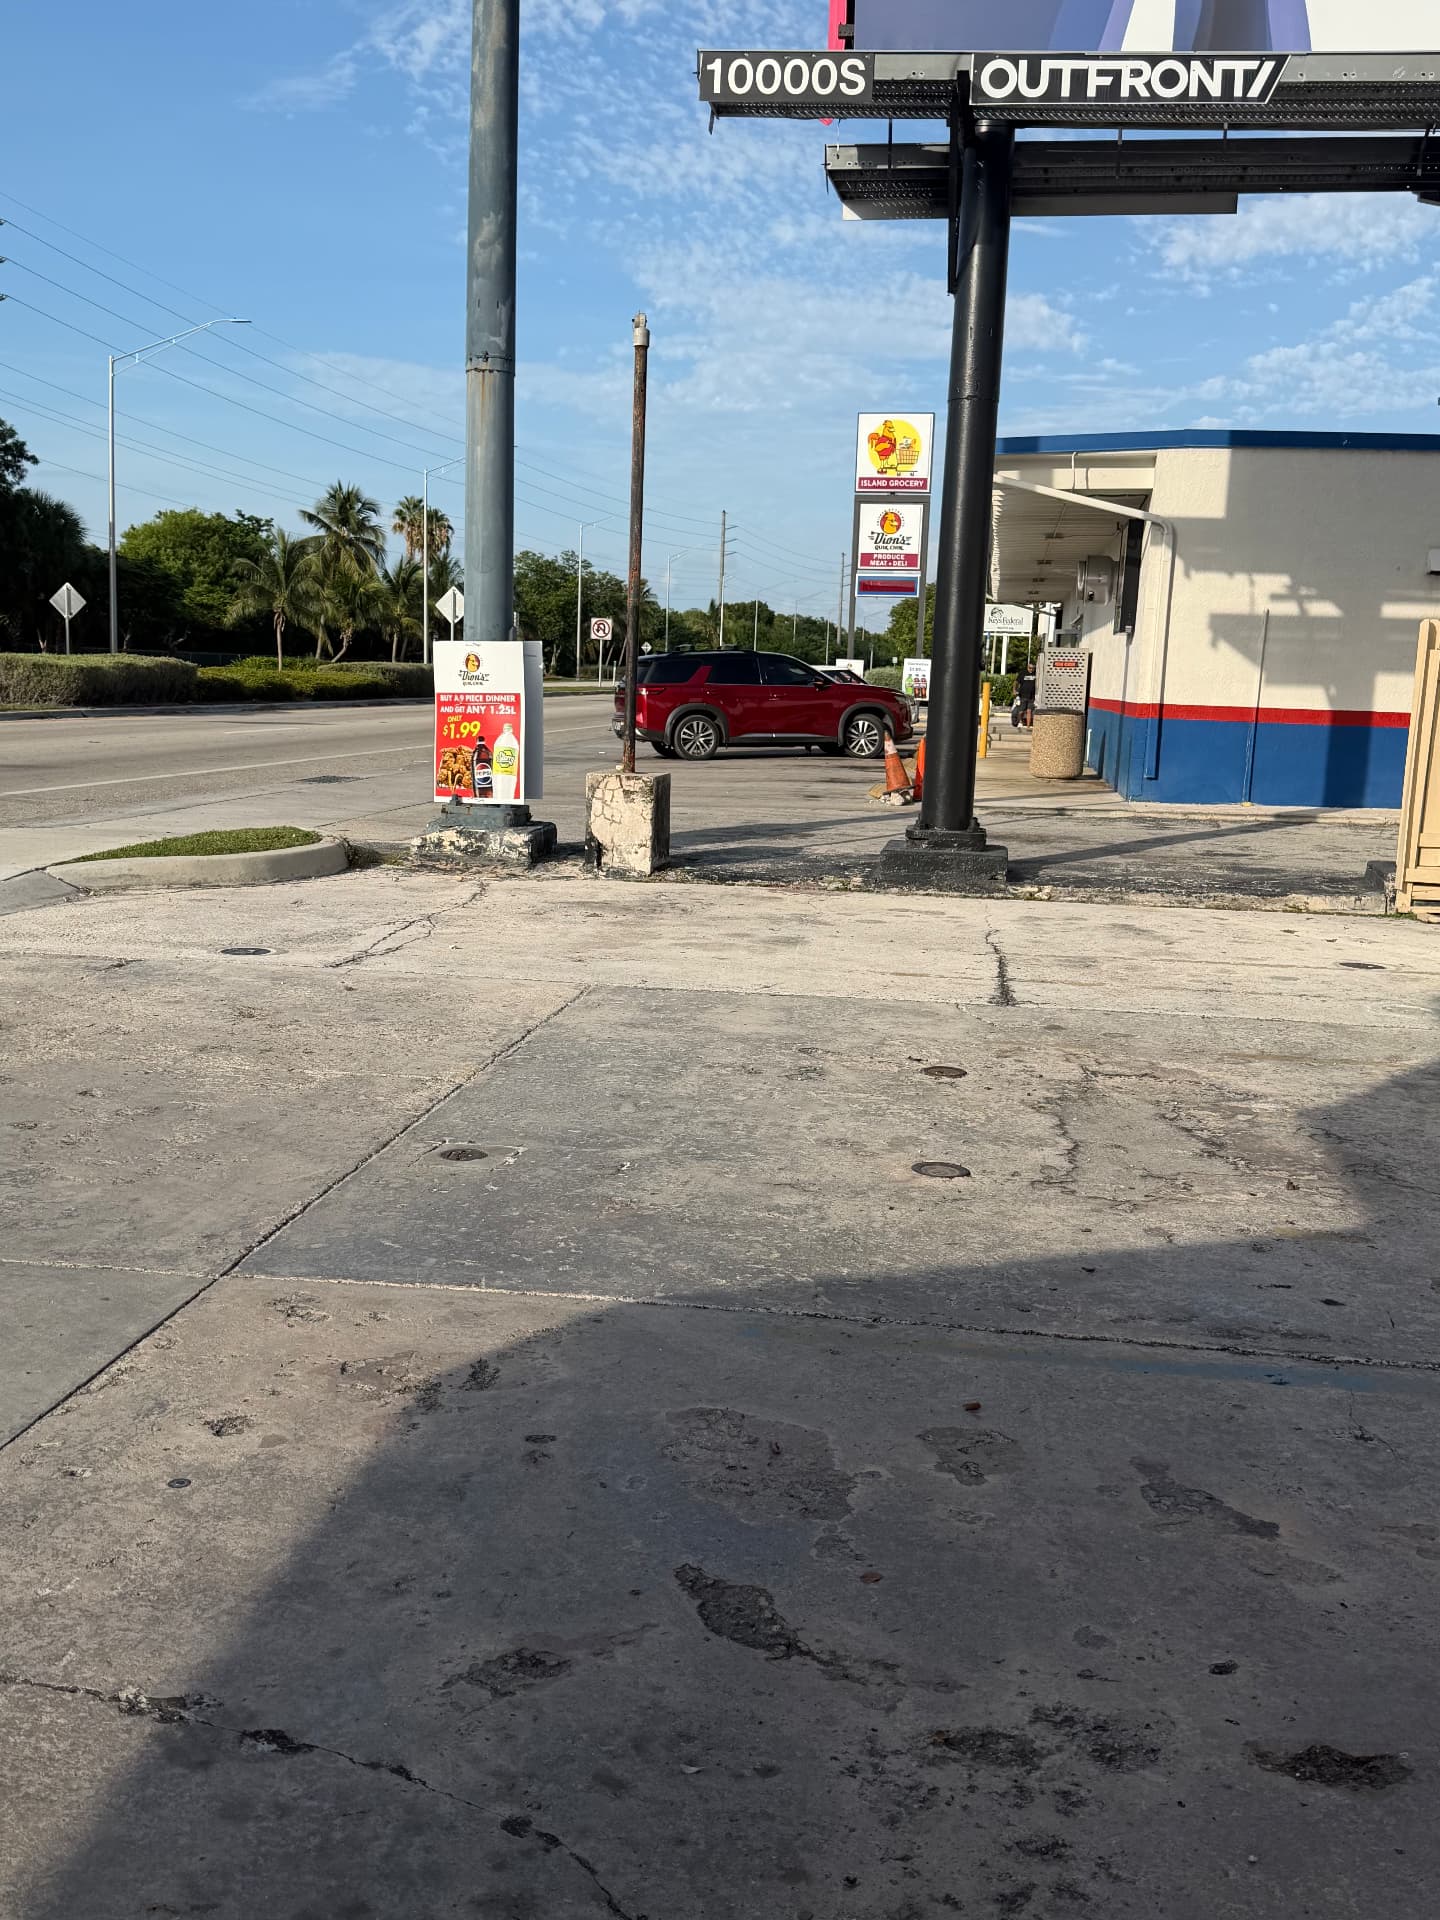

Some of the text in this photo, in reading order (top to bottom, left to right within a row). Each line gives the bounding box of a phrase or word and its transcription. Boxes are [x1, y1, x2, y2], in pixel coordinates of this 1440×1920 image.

[706, 58, 866, 96] 10000S
[860, 479, 924, 487] ISLAND GROCERY
[871, 531, 911, 546] Dion's
[460, 670, 490, 682] Dion's
[440, 694, 453, 702] BUY
[454, 694, 459, 702] A
[465, 694, 483, 702] PIECE
[485, 694, 516, 703] DINNER
[440, 705, 454, 713] AND
[466, 705, 486, 714] ANY
[490, 705, 516, 715] 1.25L
[448, 714, 463, 723] ONLY
[443, 720, 481, 740] $1.99
